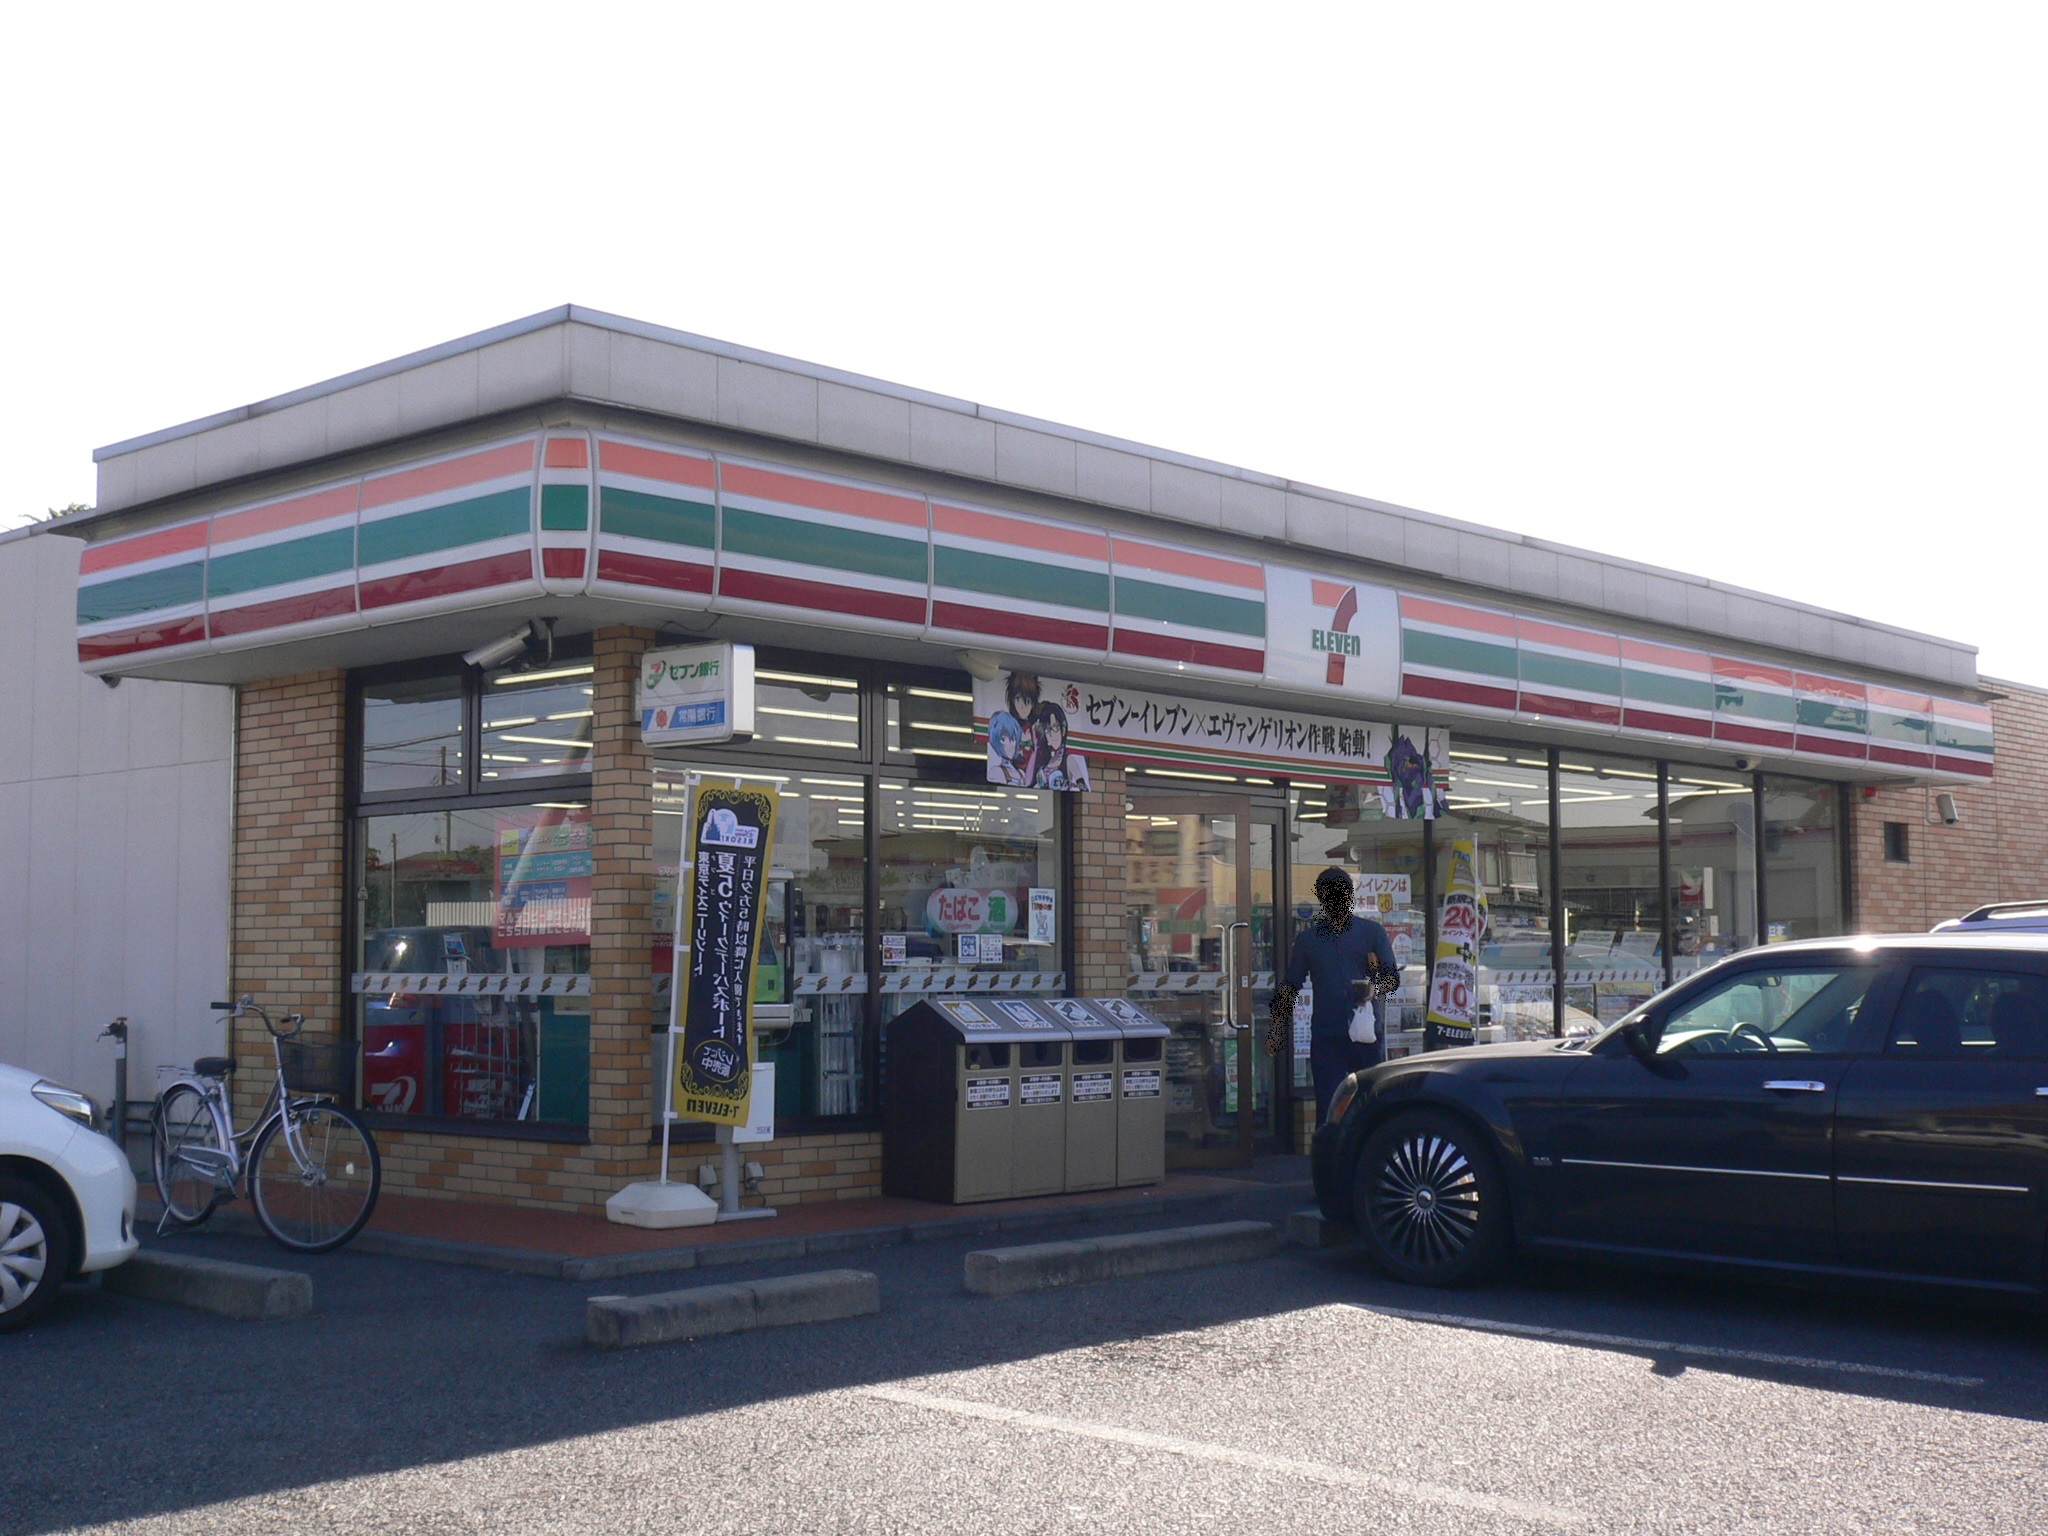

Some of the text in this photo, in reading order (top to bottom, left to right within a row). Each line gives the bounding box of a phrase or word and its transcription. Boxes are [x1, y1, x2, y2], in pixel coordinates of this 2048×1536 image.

[669, 660, 720, 681] セブン銀行
[939, 895, 980, 921] たばこ
